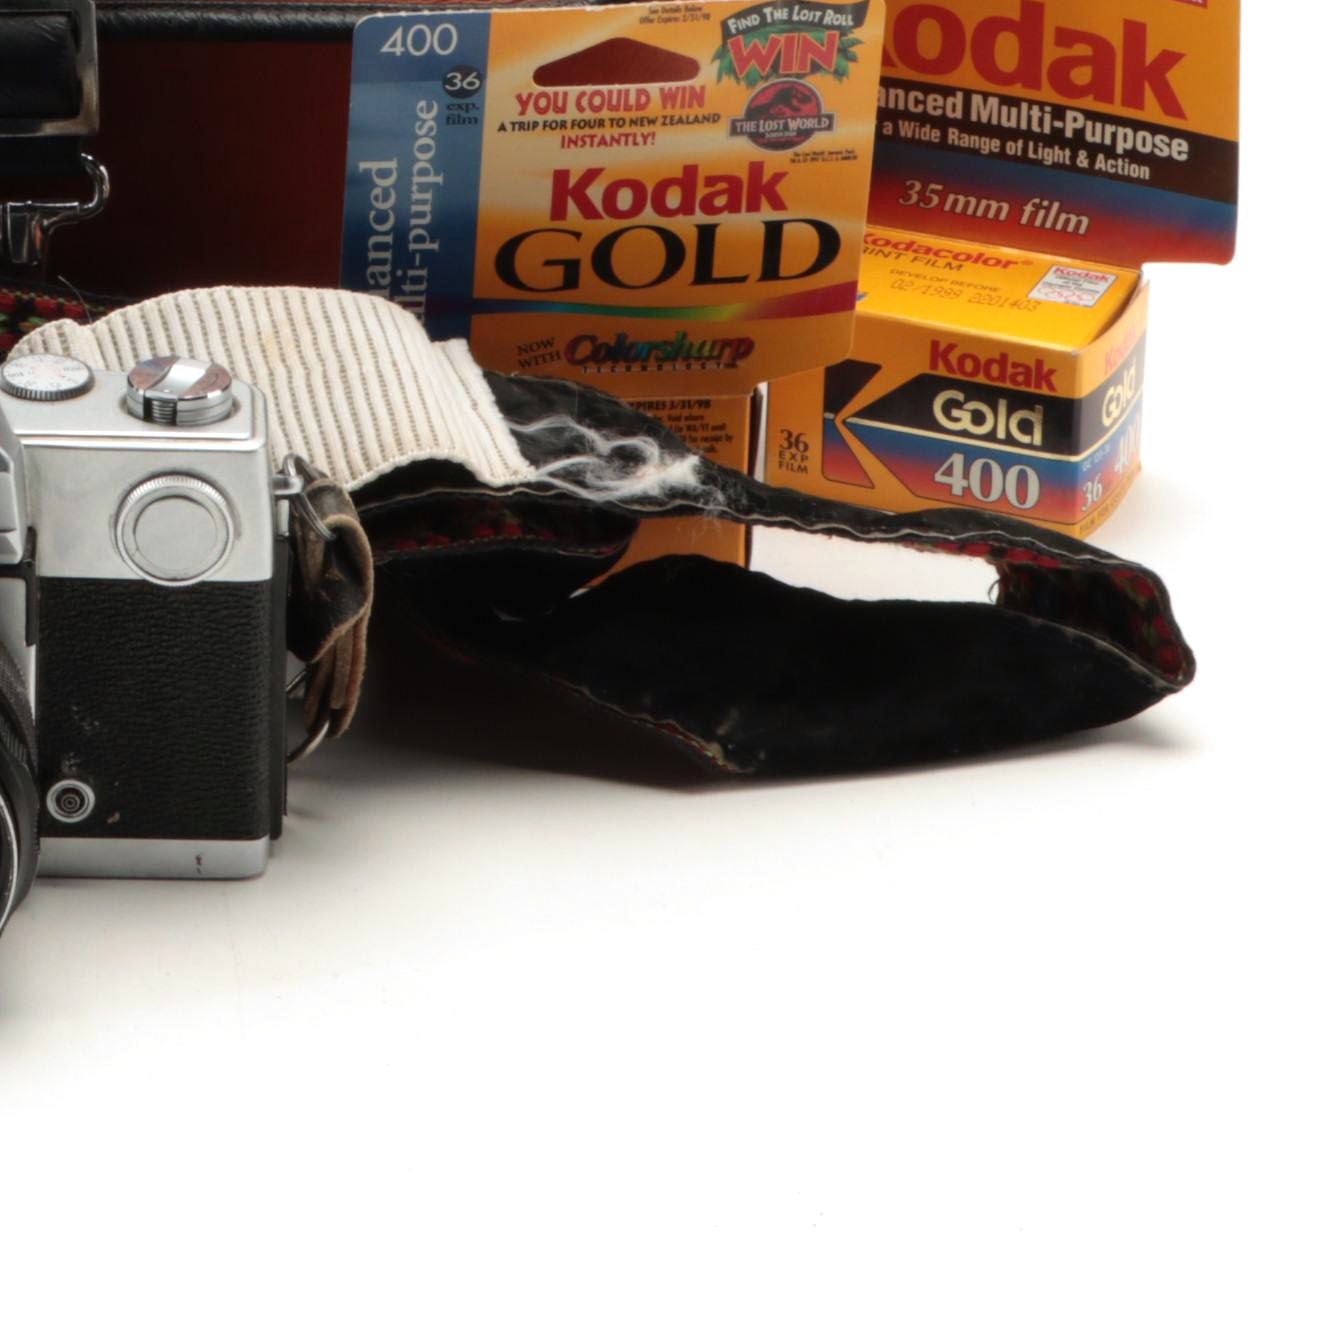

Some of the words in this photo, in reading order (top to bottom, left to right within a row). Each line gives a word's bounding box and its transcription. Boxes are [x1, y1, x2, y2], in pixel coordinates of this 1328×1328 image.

[727, 14, 760, 35] FIND
[763, 6, 789, 24] THE
[792, 4, 821, 23] LOST
[823, 8, 854, 26] ROLL
[379, 23, 458, 57] 400
[726, 30, 840, 79] WIN
[444, 71, 481, 91] 36
[446, 102, 479, 114] exp.
[515, 90, 568, 116] YOU
[575, 87, 651, 114] COULD
[660, 85, 706, 110] WIN
[446, 114, 479, 126] film
[497, 122, 508, 132] A
[511, 121, 539, 132] TRIP
[542, 120, 568, 131] FOR
[570, 118, 606, 130] FOUR
[608, 117, 626, 128] TO
[629, 115, 657, 128] NEW
[661, 112, 721, 127] ZEALAND
[736, 120, 757, 133] THE
[759, 118, 785, 132] LOST
[787, 116, 830, 131] WORLD
[877, 84, 963, 119] anced
[971, 93, 1189, 162] Multi-Purpose
[560, 132, 656, 149] INSTANTLY!
[883, 122, 893, 135] a
[899, 120, 941, 143] Wide
[948, 129, 1000, 156] Range
[1006, 138, 1023, 156] of
[1028, 141, 1072, 166] Light
[1076, 151, 1089, 169] &
[1095, 153, 1150, 180] Action
[549, 161, 789, 221] Kodak
[394, 99, 444, 322] lti-purpose
[1019, 198, 1090, 235] film
[358, 158, 399, 302] anced
[493, 218, 841, 296] GOLD
[910, 255, 964, 272] FILM
[1053, 265, 1112, 283] Kodak
[517, 336, 556, 356] NOW
[518, 349, 562, 369] WITH
[564, 330, 755, 366] Colorsharp
[929, 339, 1059, 393] Kodak
[1101, 357, 1137, 427] Gold
[933, 388, 1045, 447] Gold
[778, 452, 810, 463] EXP
[780, 429, 810, 454] 36
[778, 461, 809, 475] FILM
[934, 452, 1041, 510] 400
[1081, 472, 1104, 512] 36
